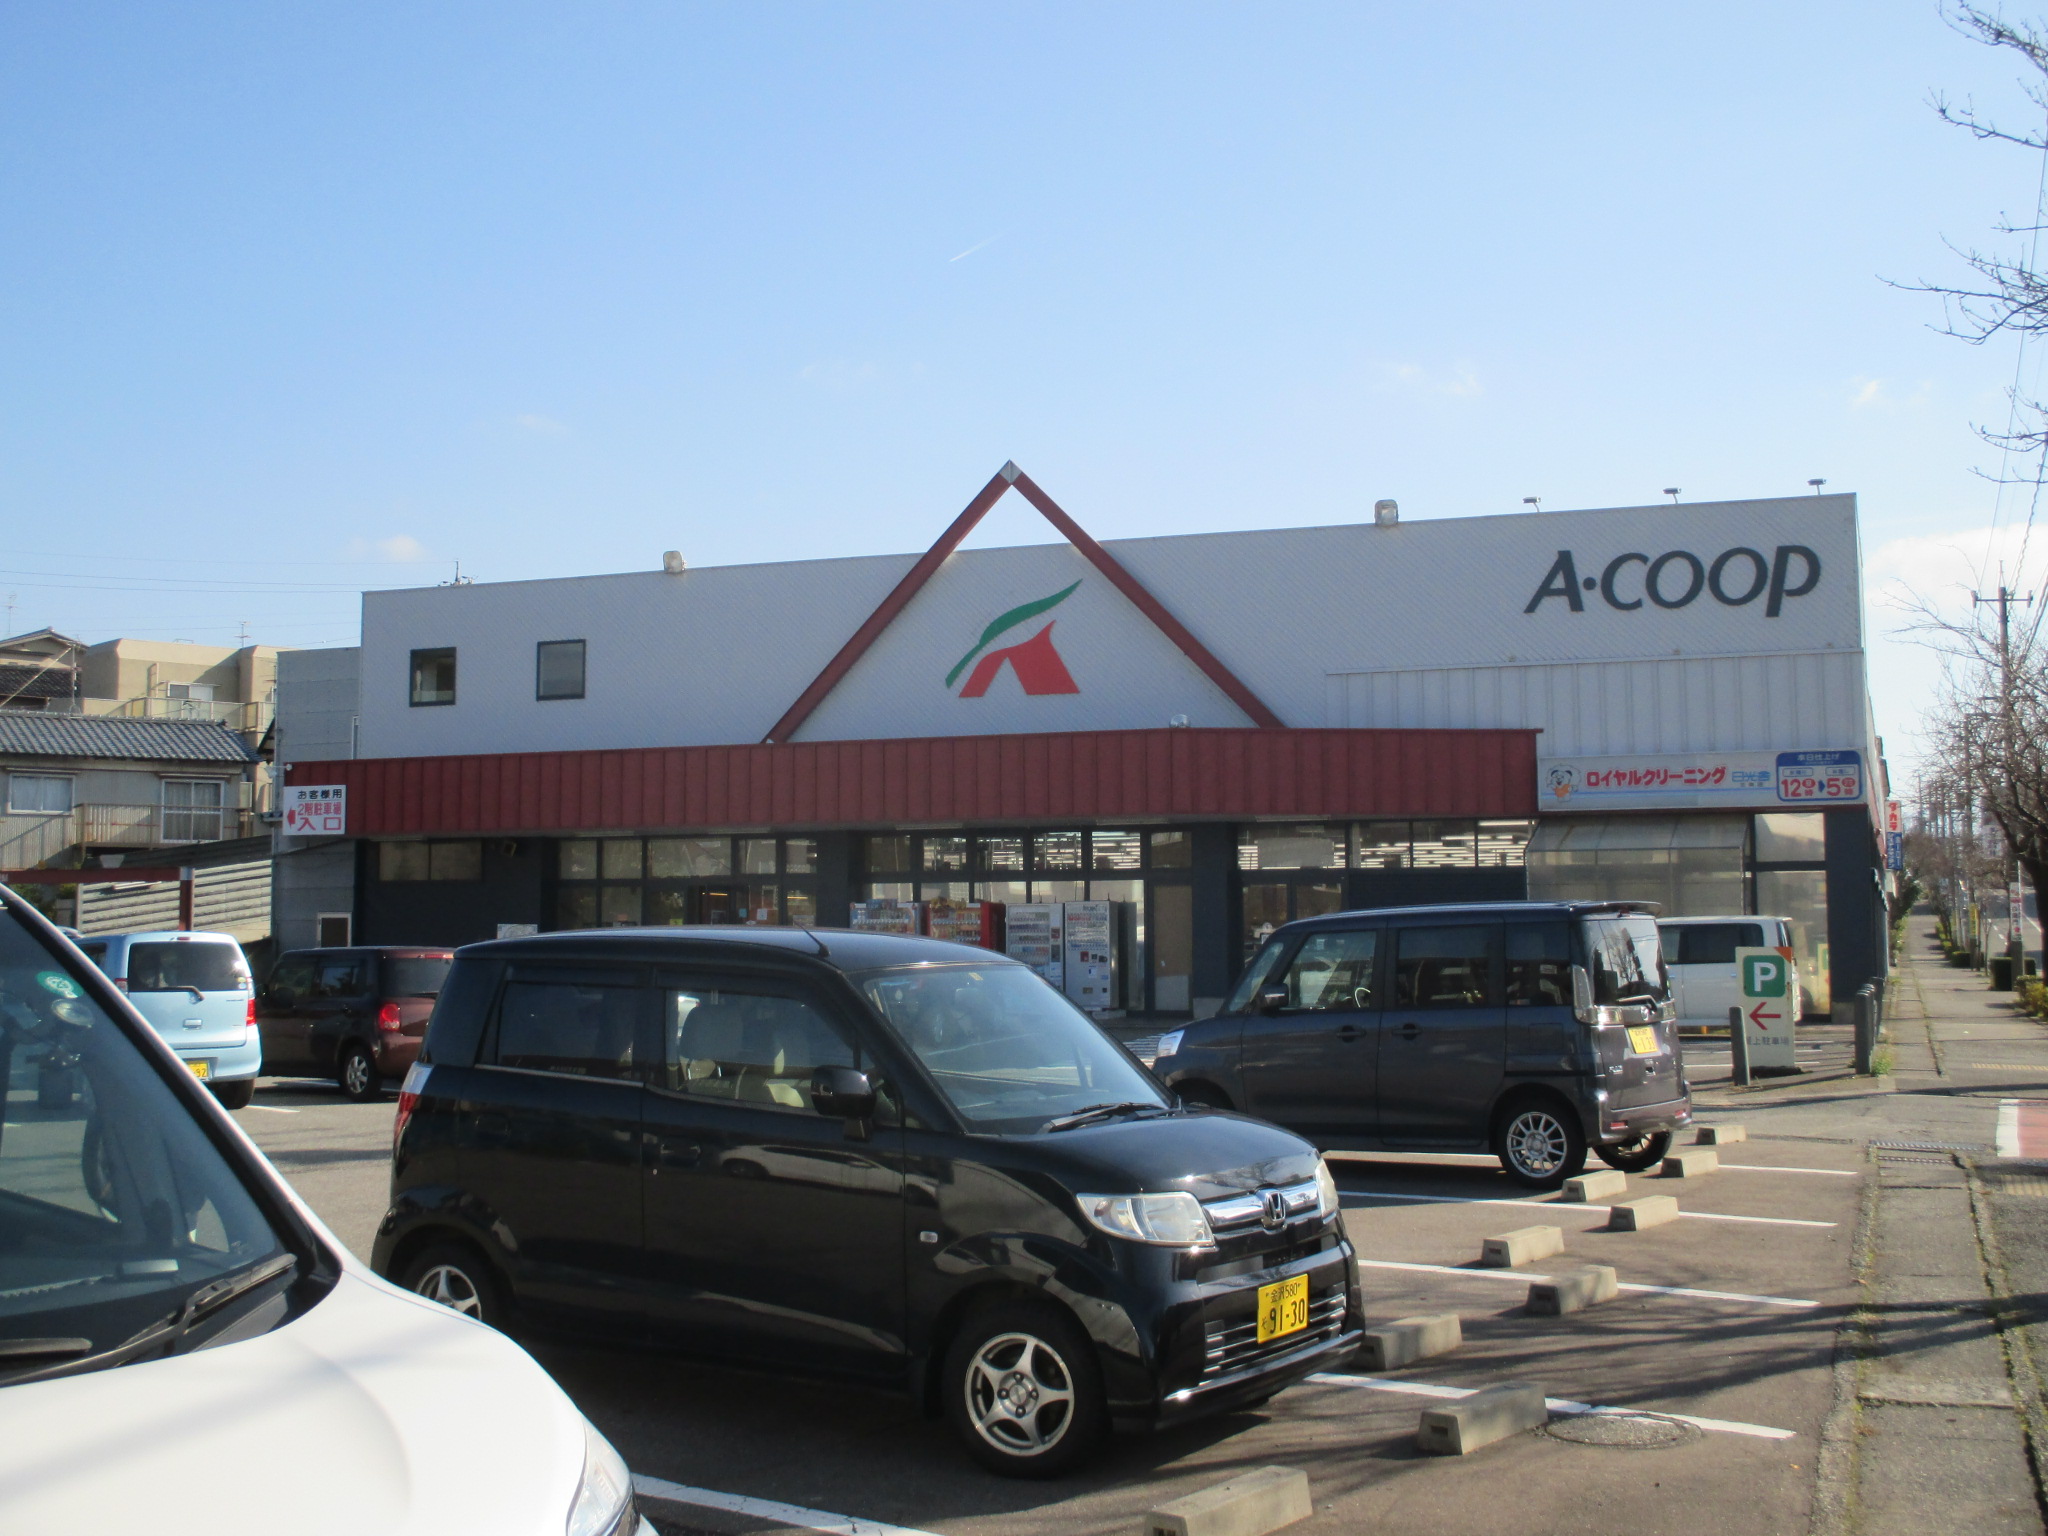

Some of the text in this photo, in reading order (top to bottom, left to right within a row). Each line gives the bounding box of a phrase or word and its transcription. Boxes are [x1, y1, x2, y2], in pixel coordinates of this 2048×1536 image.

[1586, 766, 1727, 788] ロイヤルクリーニング
[297, 789, 343, 800] お客様用
[297, 802, 342, 816] 2階駐車場
[1888, 802, 1898, 831] タカラ
[297, 816, 342, 831] 入口
[1753, 962, 1778, 992] P
